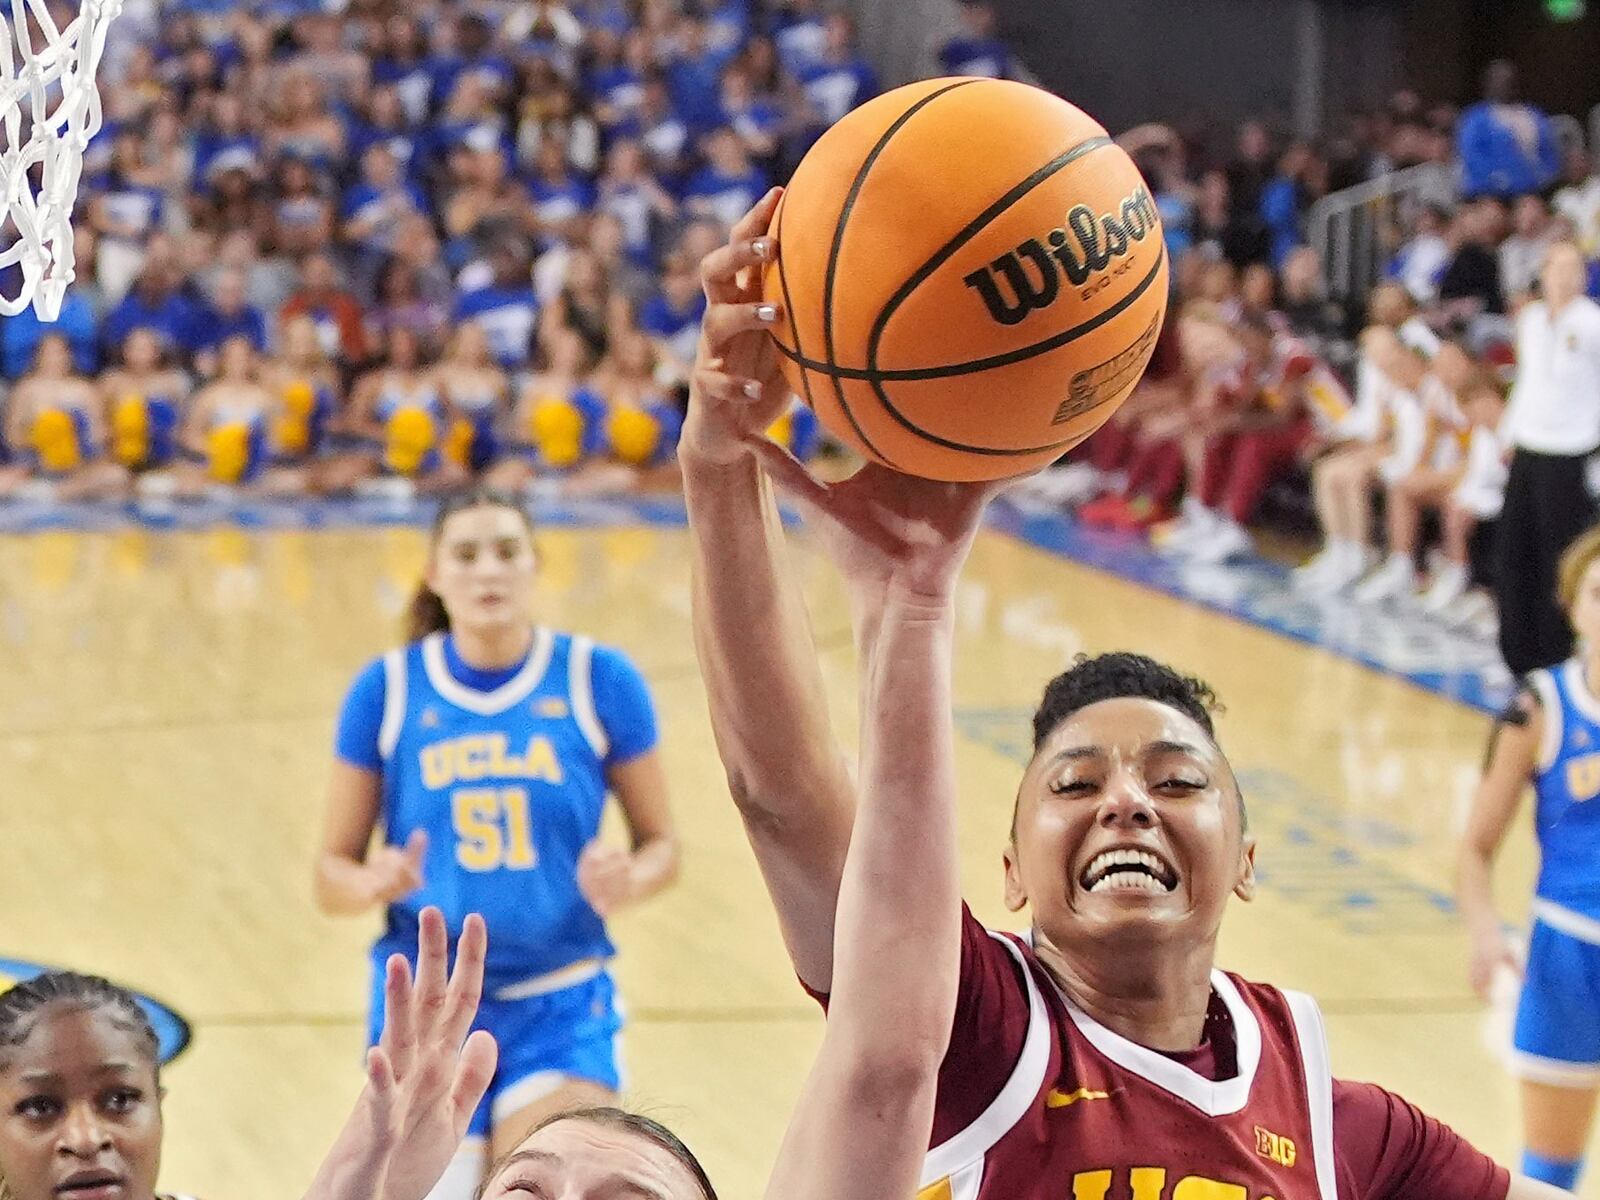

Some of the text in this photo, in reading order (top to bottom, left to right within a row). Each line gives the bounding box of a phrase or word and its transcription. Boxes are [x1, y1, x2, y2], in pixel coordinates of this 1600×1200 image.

[962, 182, 1161, 325] Wilson
[419, 731, 566, 790] UCLA
[452, 787, 539, 873] 51
